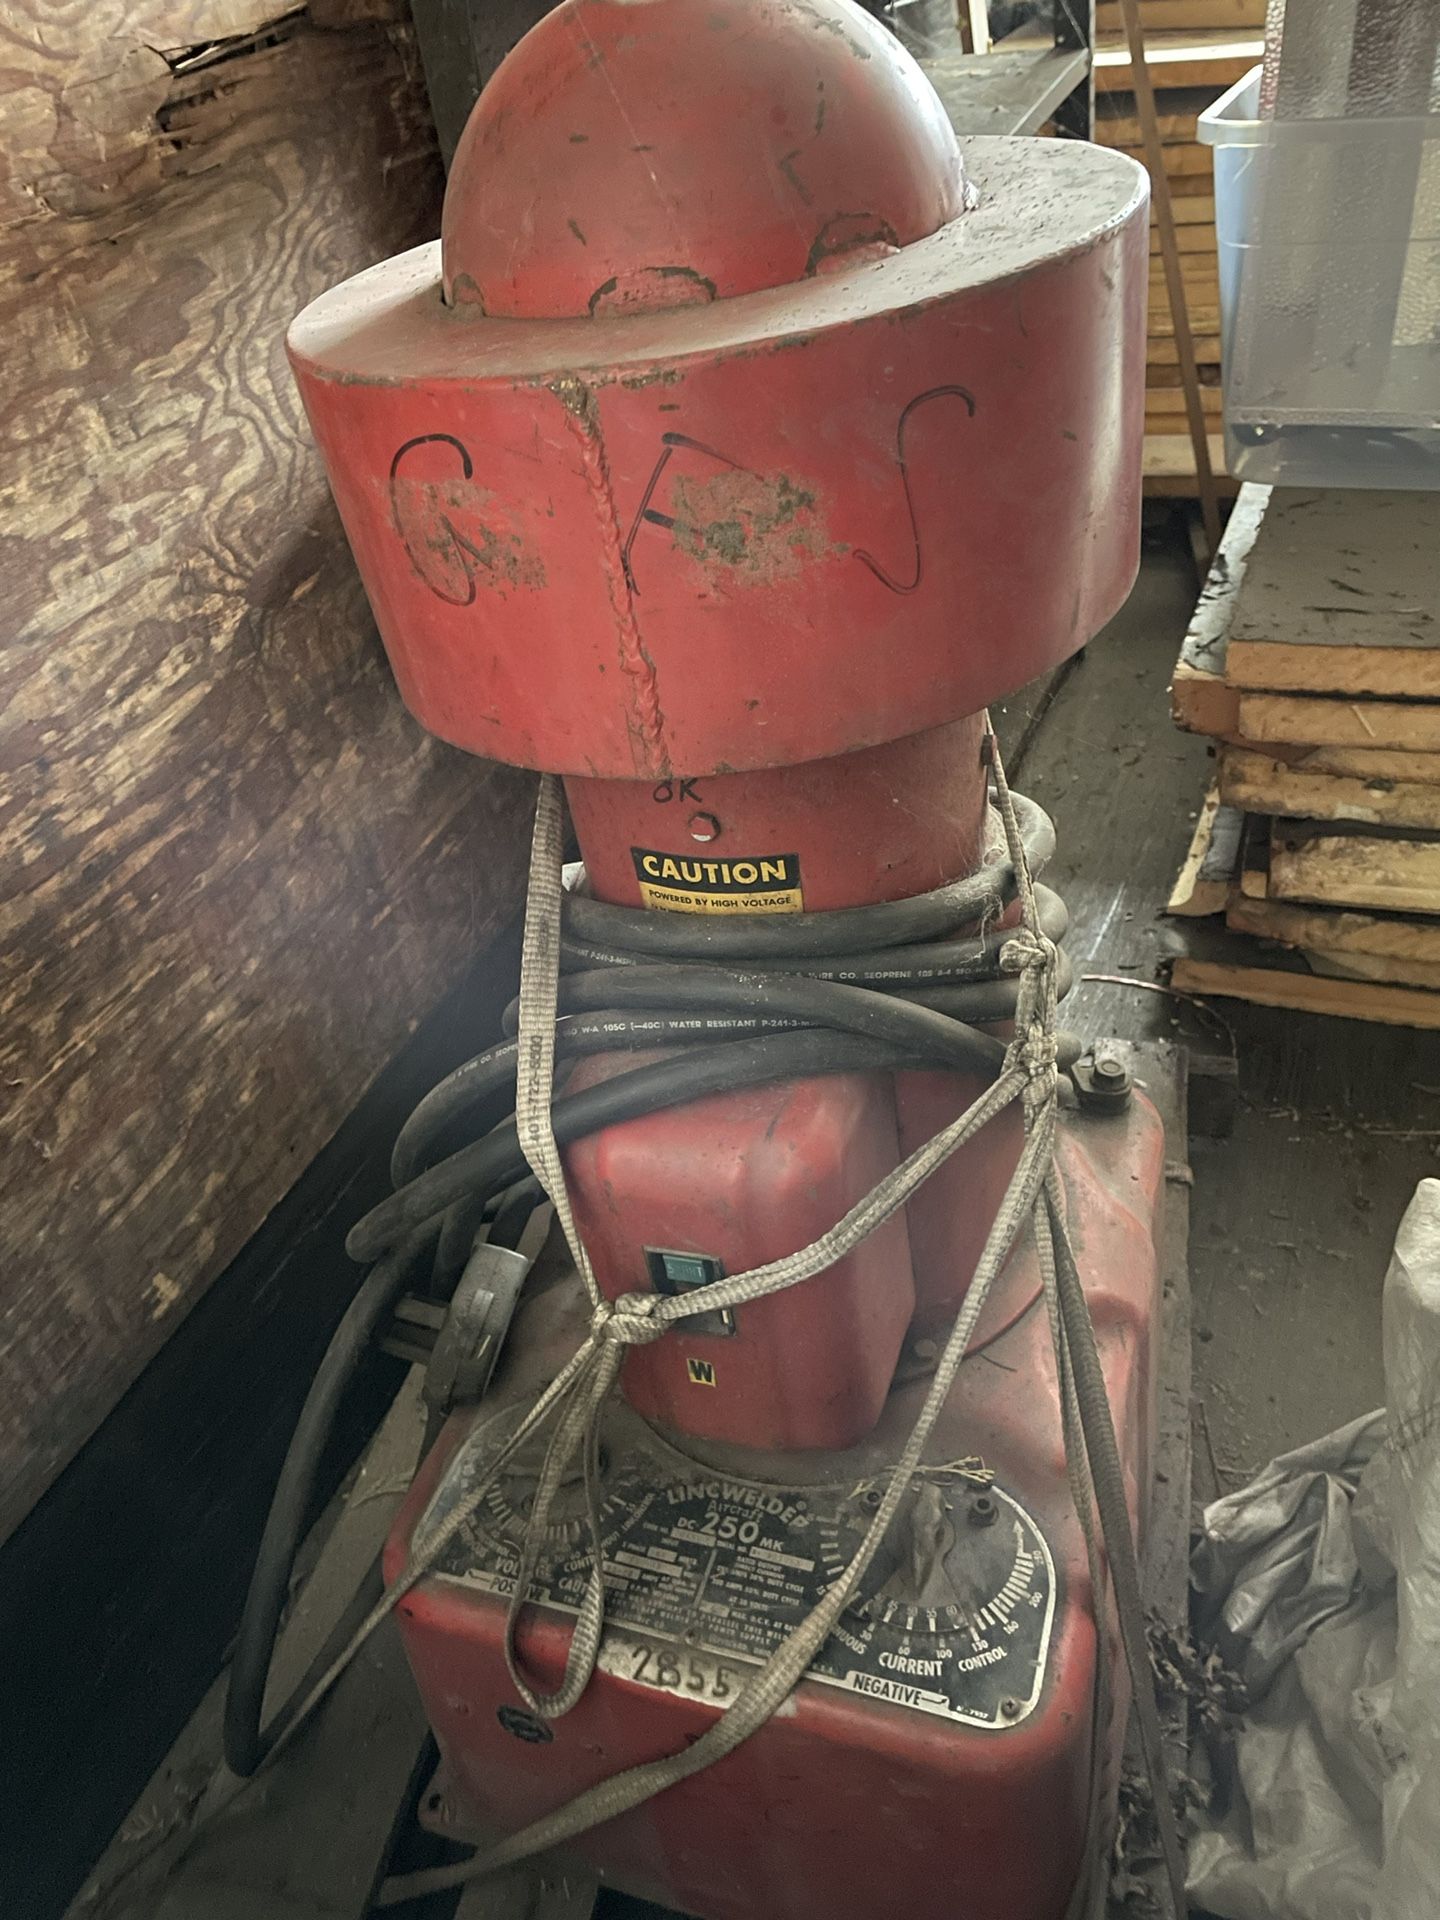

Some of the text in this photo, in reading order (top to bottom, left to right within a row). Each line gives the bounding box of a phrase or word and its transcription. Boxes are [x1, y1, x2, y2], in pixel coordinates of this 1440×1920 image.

[642, 855, 787, 885] CAUTION
[648, 889, 792, 907] POWERED BY HIGH VOLTAGE
[668, 1020, 702, 1030] WATER
[706, 1019, 757, 1029] RESISTANT
[689, 1359, 713, 1384] W
[707, 1500, 766, 1523] Aircraft
[677, 1516, 695, 1530] DC
[700, 1511, 760, 1544] 250
[759, 1537, 785, 1552] MK
[859, 1629, 873, 1641] 30
[936, 1649, 953, 1659] 100
[971, 1638, 989, 1653] 130
[631, 1645, 740, 1698] 2855
[878, 1651, 944, 1677] CURRENT
[957, 1645, 1008, 1673] CONTROL
[852, 1673, 922, 1706] NEGATIVE
